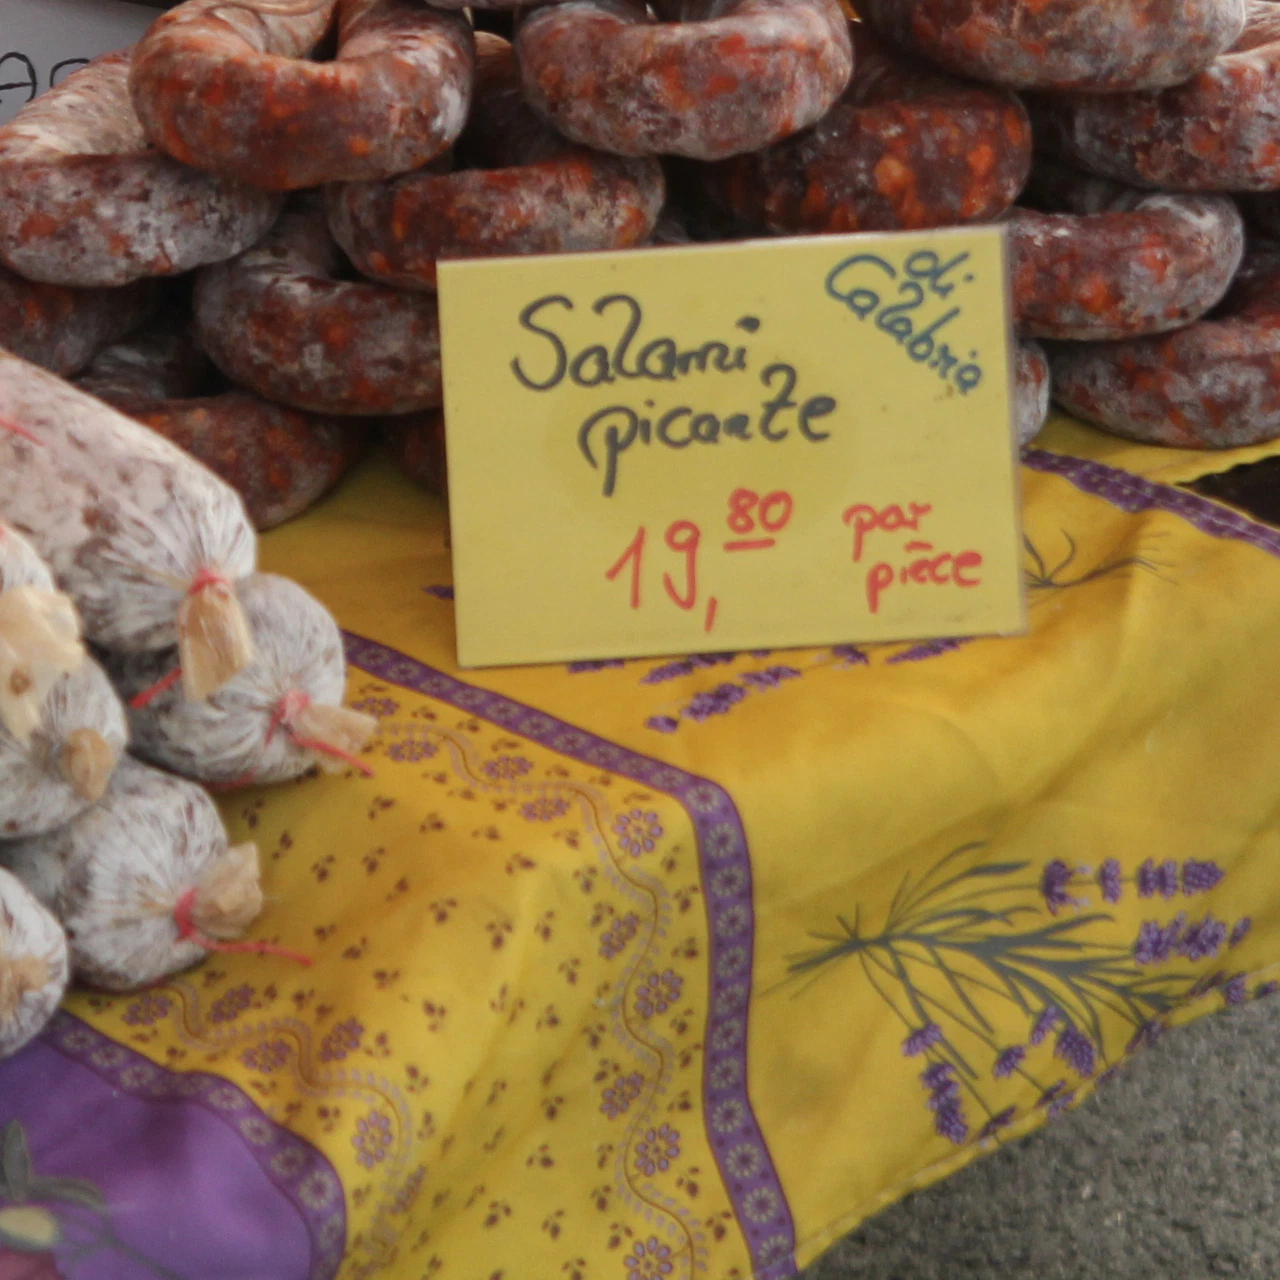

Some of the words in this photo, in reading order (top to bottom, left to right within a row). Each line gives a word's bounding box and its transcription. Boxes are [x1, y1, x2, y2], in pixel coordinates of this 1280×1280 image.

[509, 292, 762, 392] Salami
[576, 363, 838, 498] picante
[842, 502, 933, 563] par
